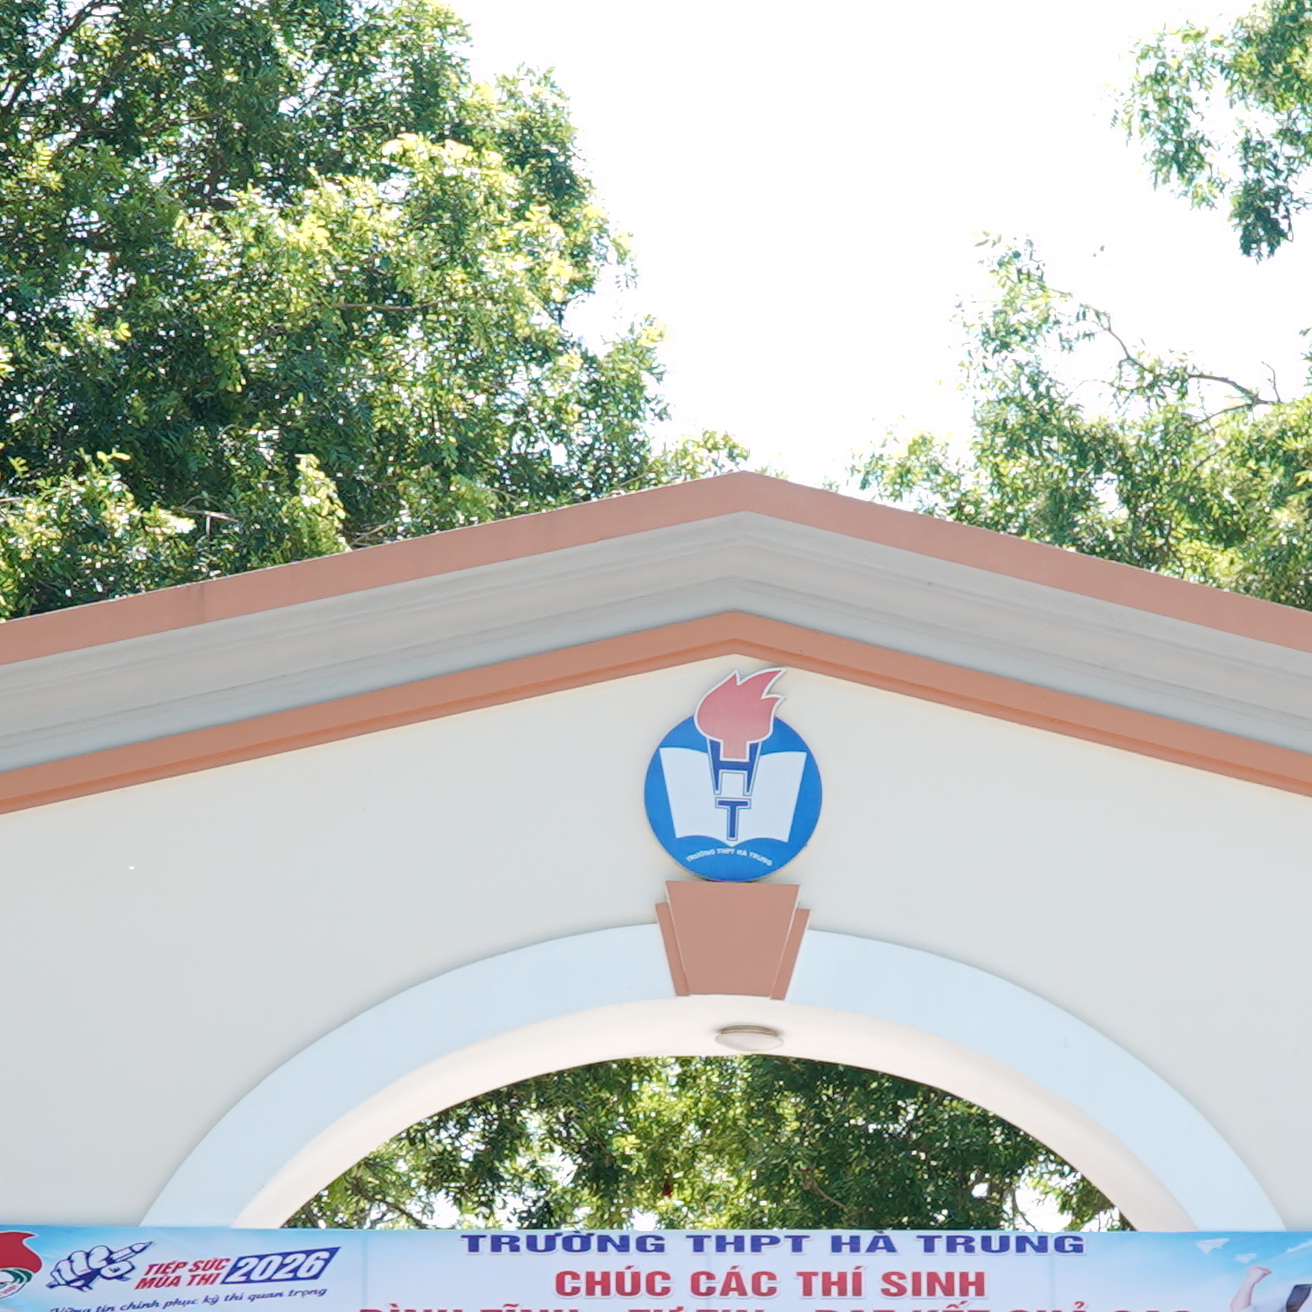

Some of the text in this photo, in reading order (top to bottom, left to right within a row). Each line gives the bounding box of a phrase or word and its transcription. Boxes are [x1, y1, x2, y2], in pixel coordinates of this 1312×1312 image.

[461, 1231, 1085, 1254] TRƯỜNG THPT HÀ TRUNG
[143, 1257, 232, 1277] TIẾP SỨC
[223, 1250, 331, 1284] 2026
[187, 1272, 222, 1287] THI
[554, 1265, 986, 1297] CHÚC CÁC THÍ SINH
[96, 1303, 116, 1312] tin
[120, 1299, 160, 1312] chinh
[224, 1291, 244, 1302] thi
[247, 1290, 284, 1303] quan
